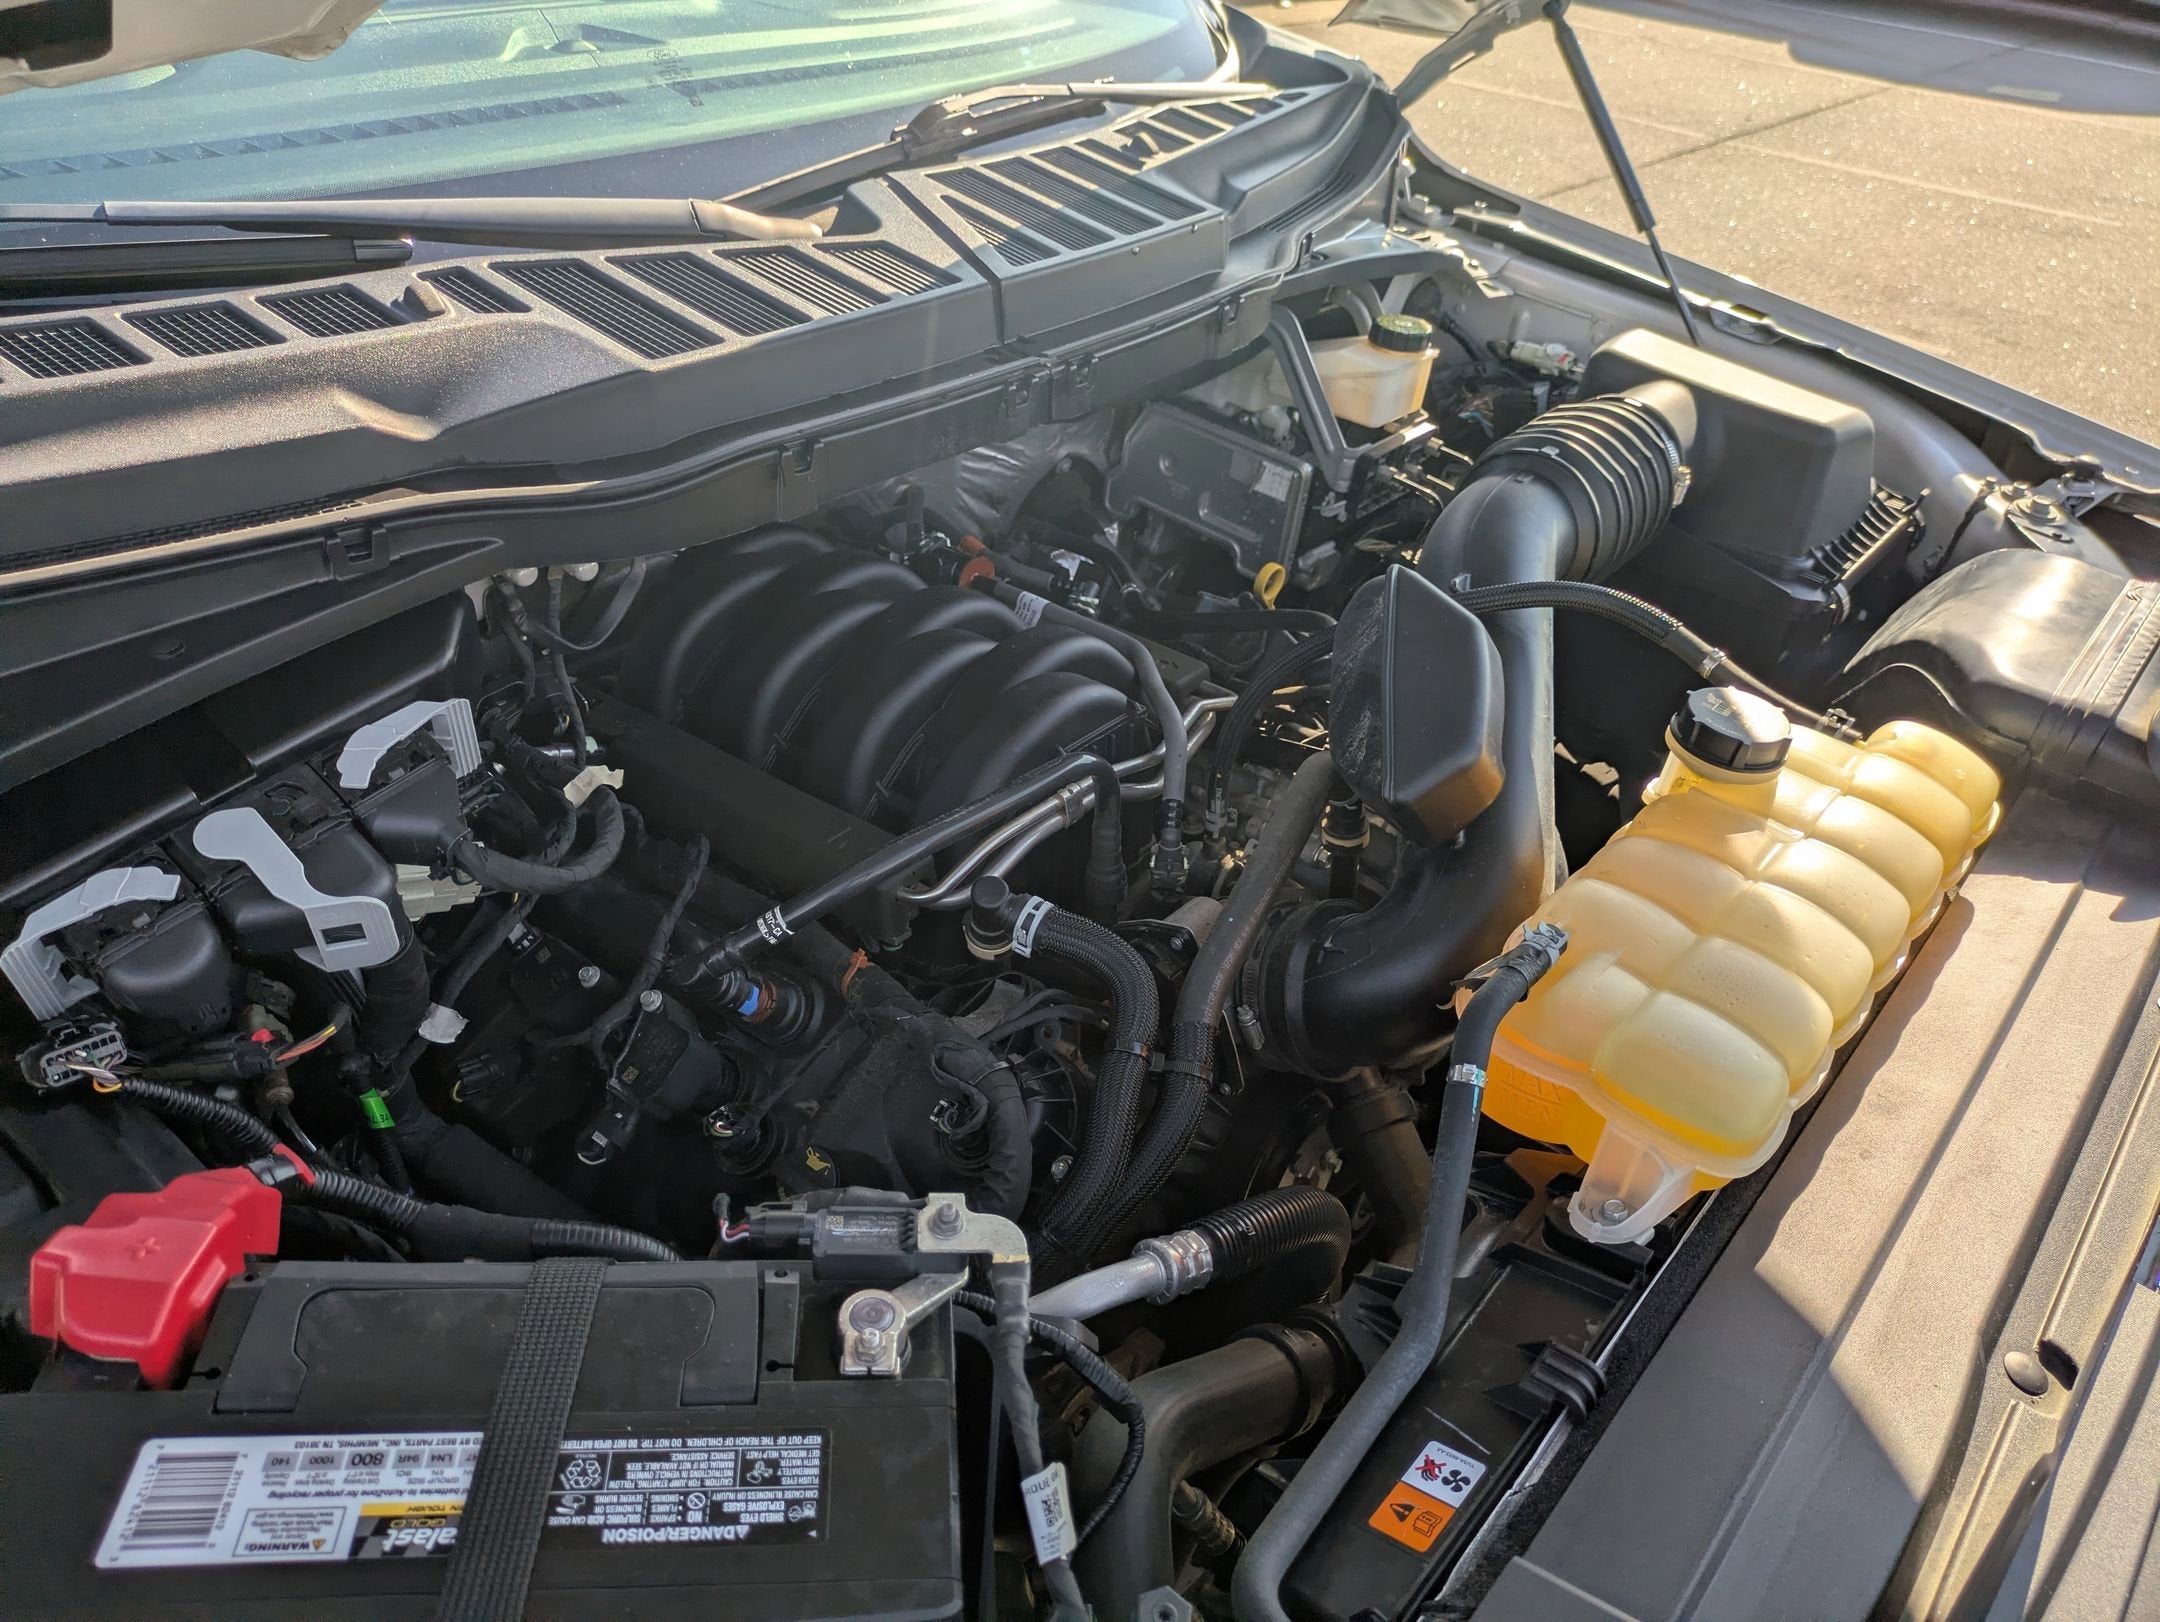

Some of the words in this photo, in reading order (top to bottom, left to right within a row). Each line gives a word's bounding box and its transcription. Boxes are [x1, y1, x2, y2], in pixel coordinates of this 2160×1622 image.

[1500, 1065, 1562, 1102] MAX
[1500, 1087, 1560, 1126] MIN
[337, 1440, 380, 1448] MEMPHIS,
[404, 1438, 433, 1447] PARTS,
[434, 1438, 457, 1446] BEST
[459, 1438, 471, 1446] BY
[613, 1440, 627, 1448] NOT
[627, 1439, 638, 1448] DO
[654, 1439, 670, 1448] NOT
[671, 1438, 682, 1447] DO
[724, 1437, 734, 1446] OF
[736, 1436, 760, 1446] REACH
[760, 1436, 774, 1445] THE
[776, 1436, 787, 1445] OF
[787, 1436, 803, 1444] OUT
[803, 1435, 821, 1444] KEEP
[294, 1441, 321, 1449] 38103
[594, 1440, 612, 1449] OPEN
[431, 1453, 453, 1462] LN4
[710, 1451, 735, 1460] SERVICE
[744, 1450, 762, 1459] FAST.
[763, 1450, 779, 1459] HELP
[780, 1449, 807, 1458] MEDICAL
[808, 1449, 820, 1458] GET
[271, 1457, 290, 1466] 140
[309, 1455, 336, 1465] 1000
[351, 1452, 384, 1467] 800
[398, 1454, 420, 1463] 94R
[804, 1458, 820, 1466] WITH
[625, 1462, 642, 1471] SEEK
[679, 1461, 691, 1469] NOT
[699, 1461, 709, 1469] OR
[710, 1460, 734, 1469] MANUAL
[627, 1470, 654, 1479] OWNERS
[655, 1470, 680, 1479] VEHICLE
[689, 1469, 734, 1478] INSTRUCTIONS
[777, 1467, 819, 1476] IMMEDIATELY
[427, 1476, 460, 1484] GROUP
[608, 1480, 635, 1489] FOLLOW
[669, 1479, 687, 1488] JUMP
[688, 1479, 701, 1487] FOR
[703, 1478, 733, 1487] CAUTION:
[781, 1476, 798, 1485] EYES
[799, 1476, 819, 1484] FLUSH
[268, 1490, 312, 1500] recycling
[312, 1489, 345, 1497] proper
[345, 1489, 359, 1498] for
[360, 1488, 406, 1498] AutoZone
[407, 1488, 417, 1496] to
[419, 1487, 460, 1496] batteries
[711, 1491, 735, 1501] INJURY
[736, 1491, 746, 1501] OR
[747, 1490, 783, 1500] BLINDNESS
[783, 1490, 804, 1499] CAUSE
[804, 1489, 818, 1499] CAN
[594, 1494, 618, 1504] BURNS
[619, 1494, 644, 1503] SEVERE
[651, 1494, 679, 1504] SMOKING
[406, 1505, 446, 1513] TOUGH
[593, 1505, 605, 1513] OR
[606, 1504, 642, 1513] BLINDNESS
[651, 1504, 678, 1513] FLAMES
[722, 1501, 746, 1512] GASES
[747, 1500, 784, 1511] EXPLOSIVE
[572, 1516, 586, 1525] CAN
[587, 1515, 605, 1525] ACID
[606, 1514, 641, 1524] SULFURIC
[650, 1513, 676, 1522] SPARKS
[686, 1510, 702, 1522] NO
[740, 1512, 758, 1522] EYES
[759, 1511, 784, 1522] SHIELD
[390, 1517, 447, 1528] GOLD
[548, 1516, 571, 1526] CAUSE
[601, 1525, 735, 1543] DANGER/POISON
[382, 1527, 458, 1552] alast
[244, 1542, 310, 1552] WARNING:
